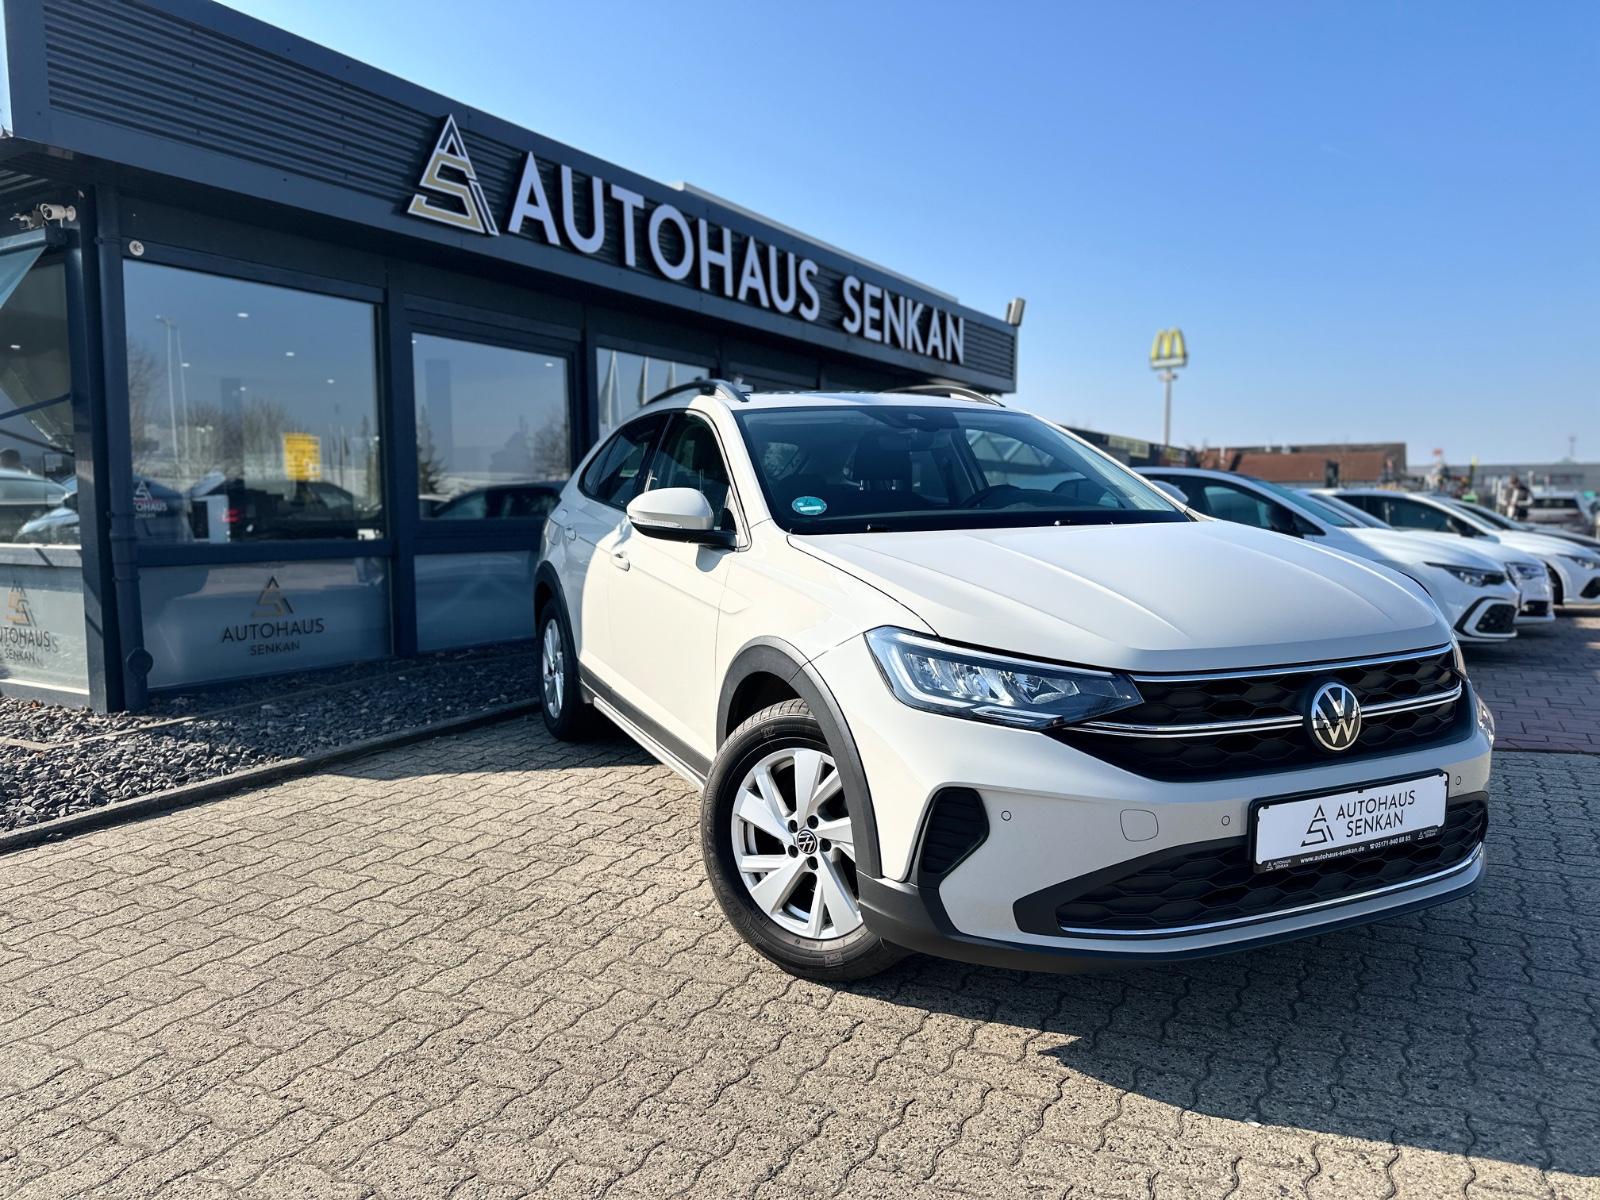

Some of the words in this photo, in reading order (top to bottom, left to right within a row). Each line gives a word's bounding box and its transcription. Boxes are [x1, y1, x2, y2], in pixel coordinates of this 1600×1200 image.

[507, 151, 820, 321] AUTOHAUS
[841, 275, 966, 364] SENKAN
[222, 618, 325, 643] AUTOHAUS
[250, 641, 300, 656] SENKAN
[1336, 790, 1416, 820] AUTOHAUS
[1346, 810, 1404, 838] SENKAN
[1300, 846, 1365, 864] www.autohaus-senkan.de
